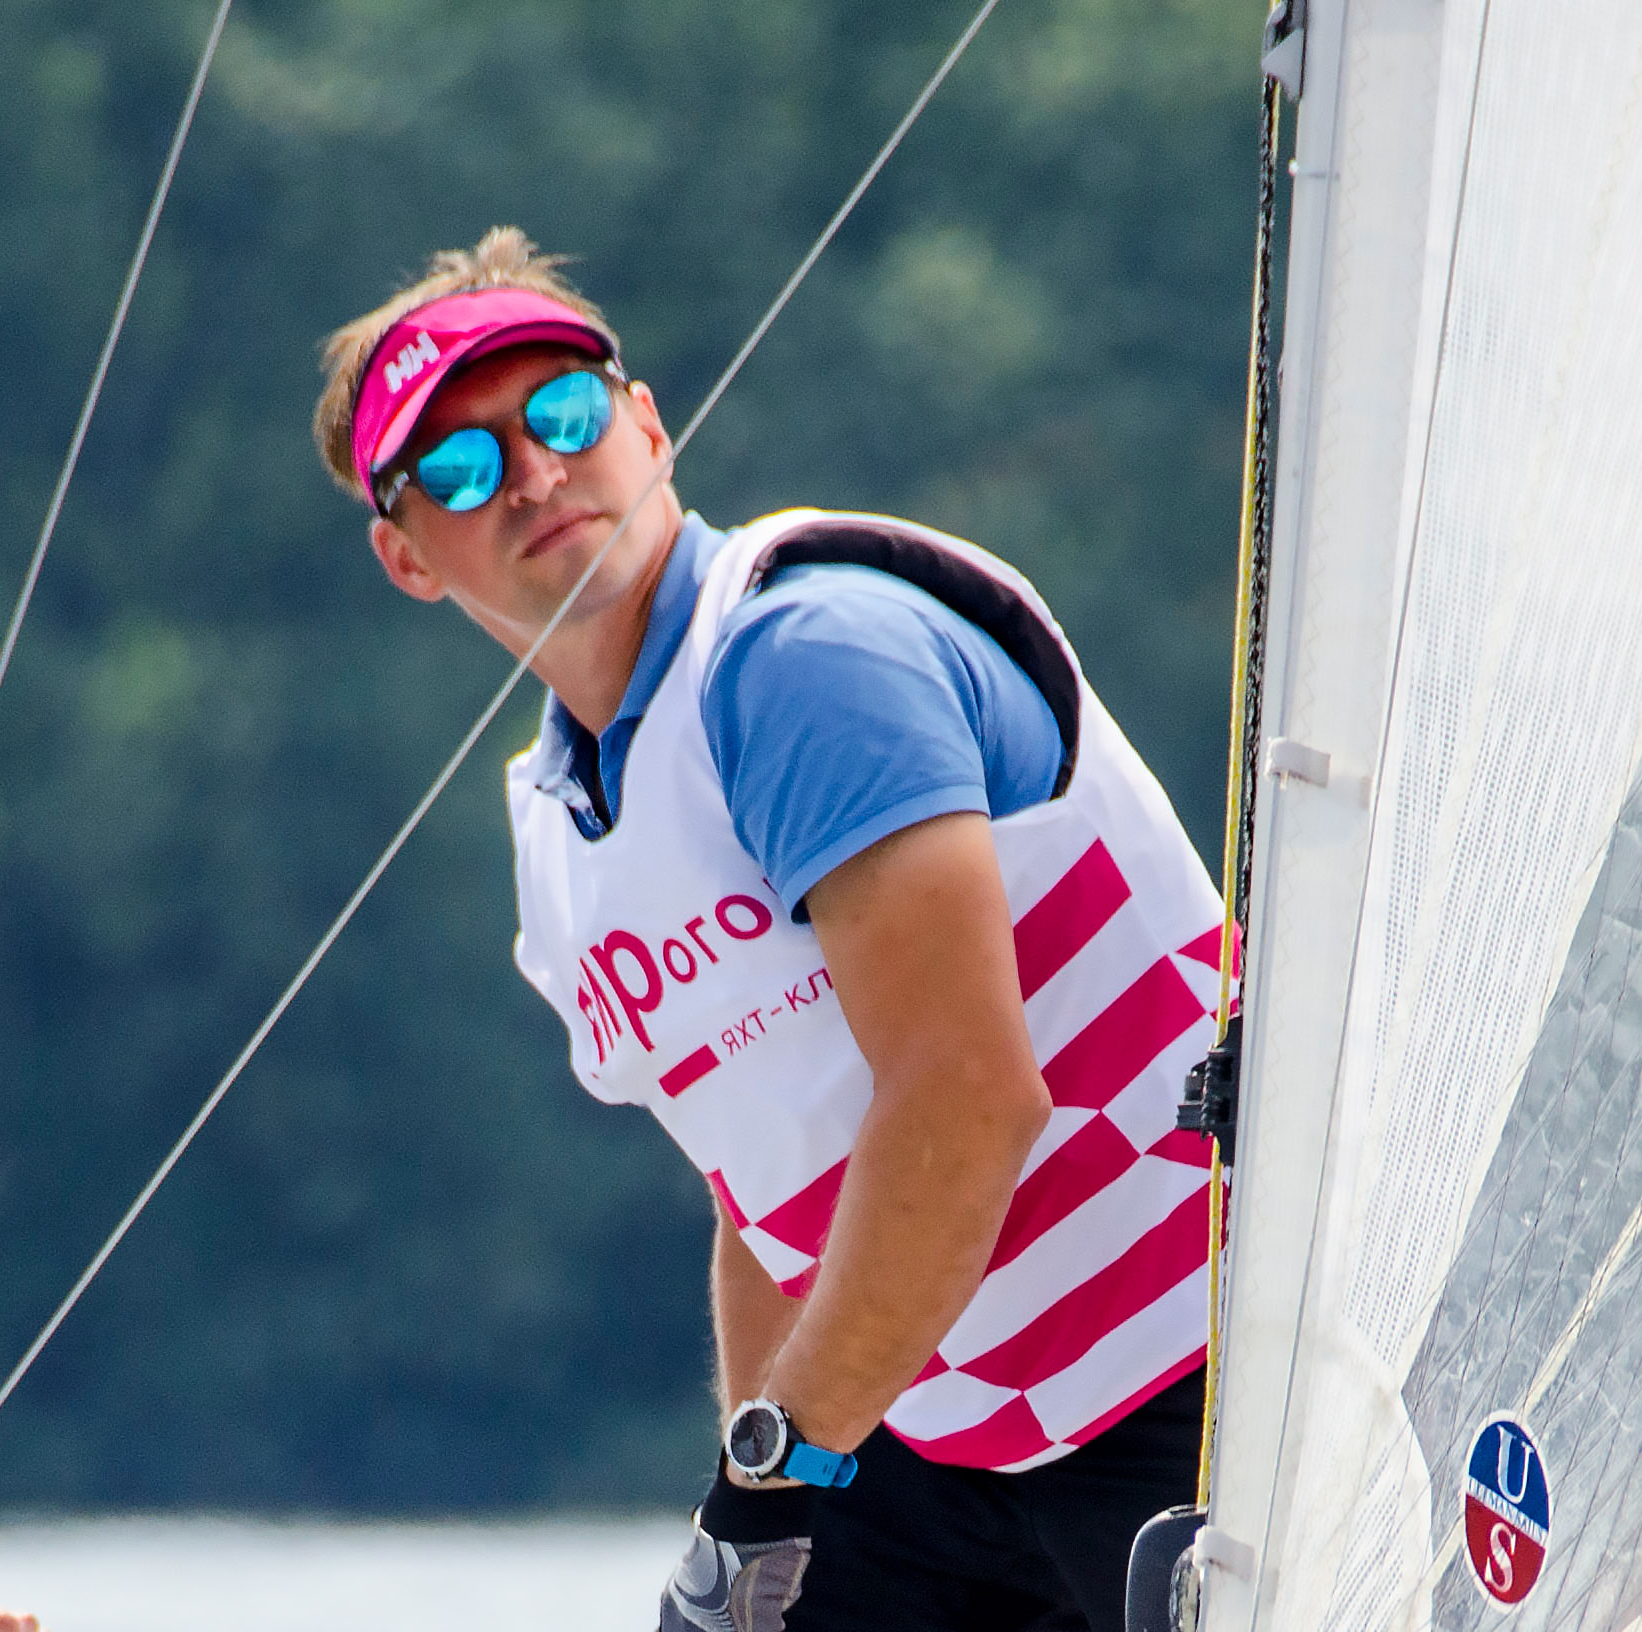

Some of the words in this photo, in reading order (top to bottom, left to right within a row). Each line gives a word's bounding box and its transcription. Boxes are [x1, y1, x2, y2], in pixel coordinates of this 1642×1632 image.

[721, 968, 834, 1056] ЯХТ-КЛ
[1497, 1424, 1535, 1504] U
[1484, 1522, 1517, 1593] S
